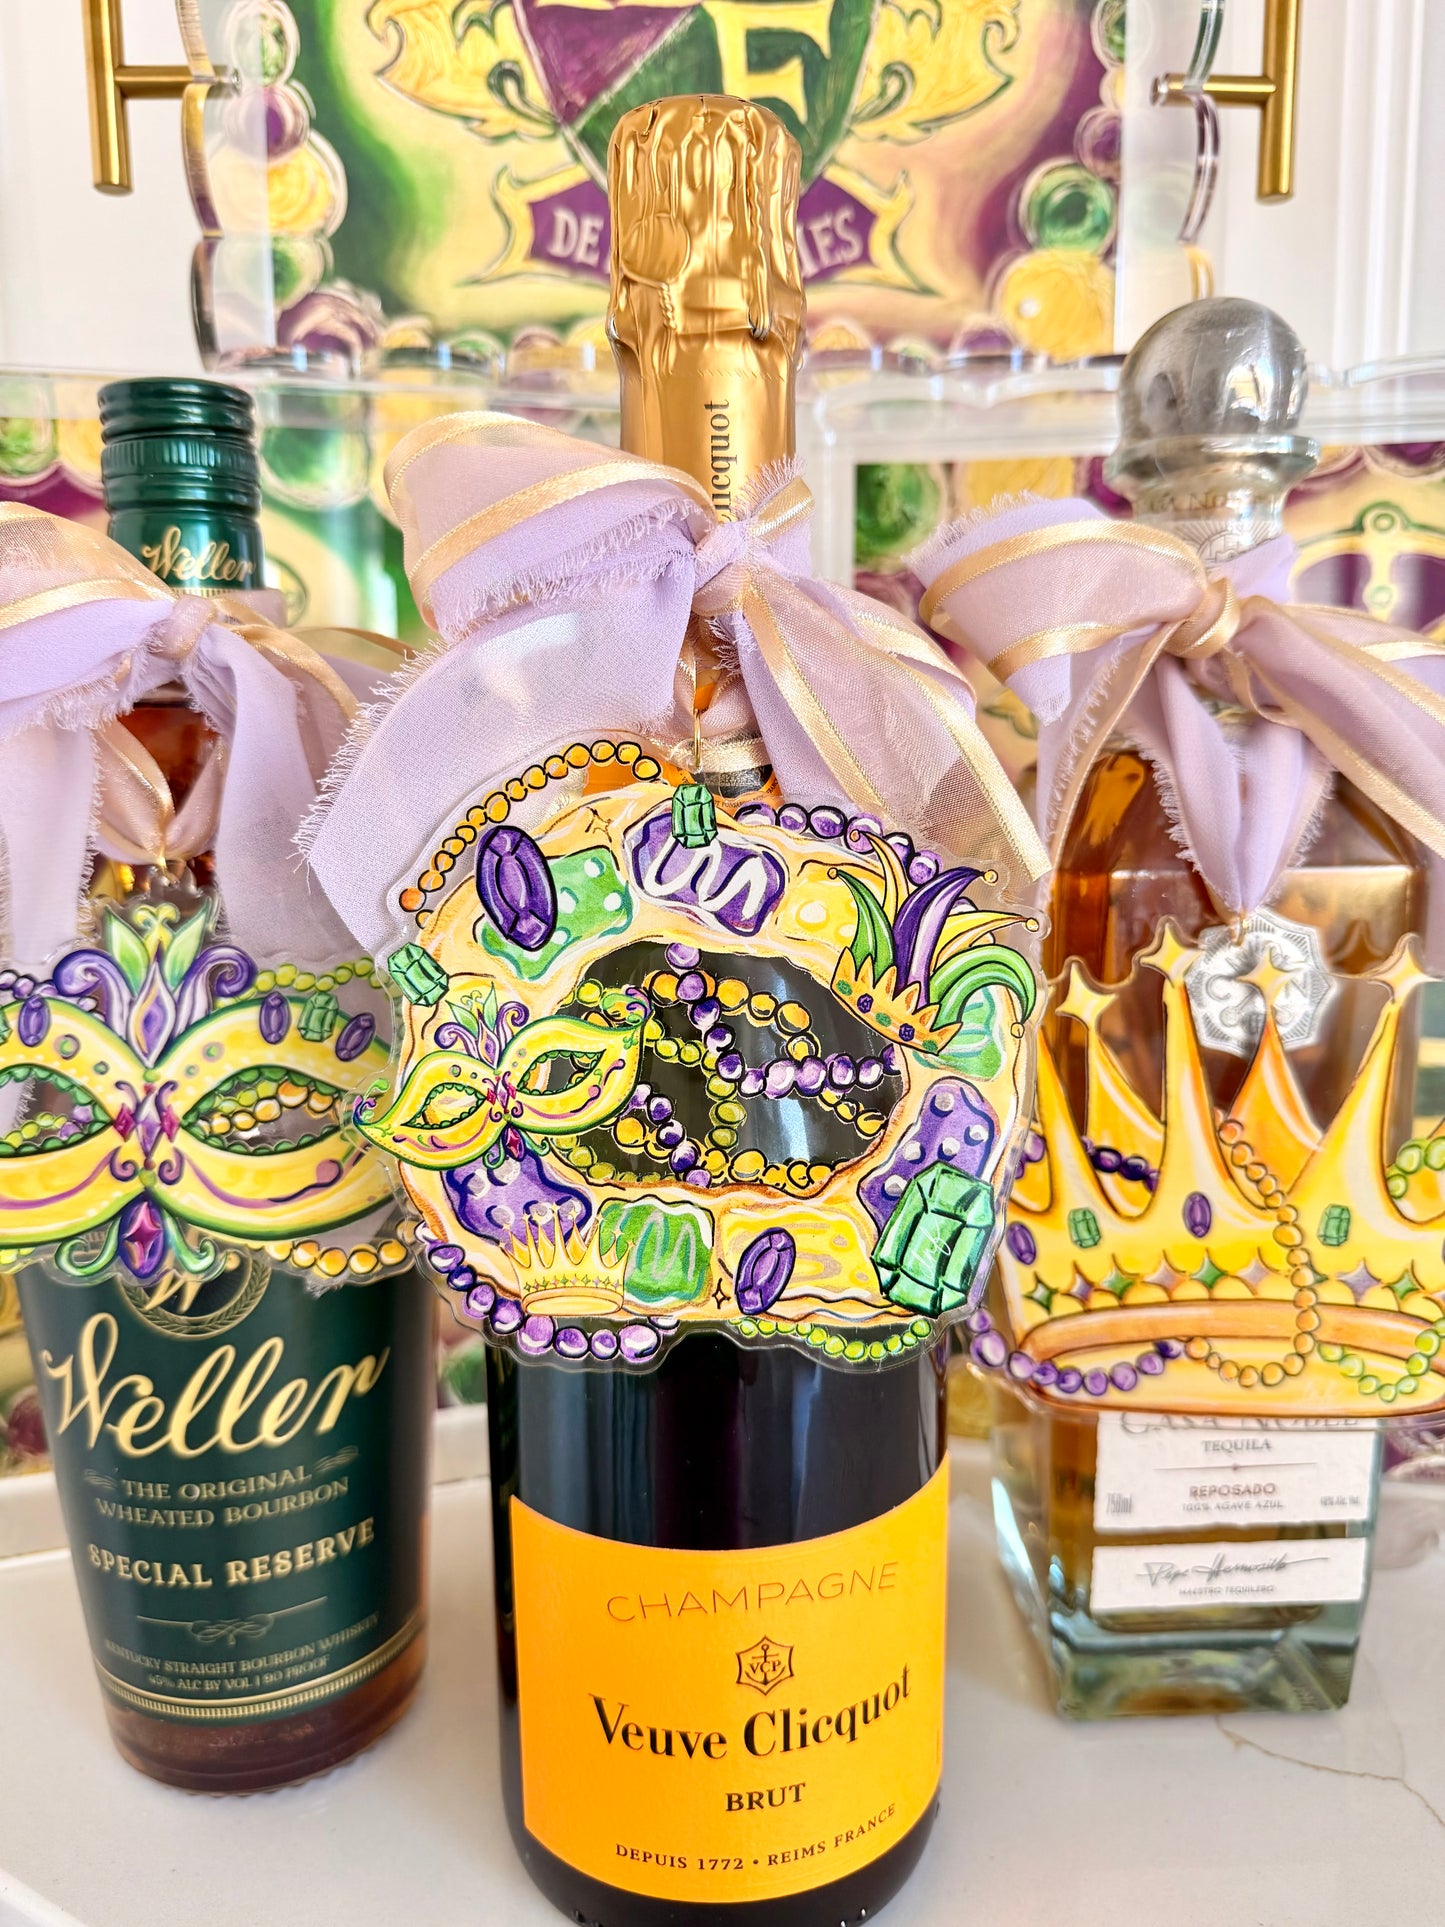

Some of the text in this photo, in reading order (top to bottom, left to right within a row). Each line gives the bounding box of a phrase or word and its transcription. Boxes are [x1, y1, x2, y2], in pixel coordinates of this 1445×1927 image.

[141, 525, 256, 583] Weller
[40, 1312, 391, 1458] Weller
[1202, 1438, 1272, 1453] TEQUILA
[96, 1476, 349, 1527] WHEATED BOURBON
[121, 1465, 313, 1500] THE ORIGINAL
[1189, 1483, 1278, 1498] REPOSADO
[1215, 1501, 1252, 1511] AGAVE
[88, 1517, 375, 1588] SPECIAL RESERVE
[606, 1560, 900, 1623] CHAMPAGNE
[164, 1660, 237, 1674] STRAIGHT
[240, 1642, 316, 1673] BOURBON
[177, 1678, 202, 1690] ALC
[203, 1679, 221, 1690] BY
[224, 1676, 252, 1690] VOL
[262, 1670, 283, 1684] 90
[284, 1653, 331, 1678] PROOF
[587, 1663, 911, 1760] Veuve Clicquot
[725, 1782, 807, 1812] BRUT
[615, 1803, 897, 1870] DEPUIS 1772 REIMS FRANCE
